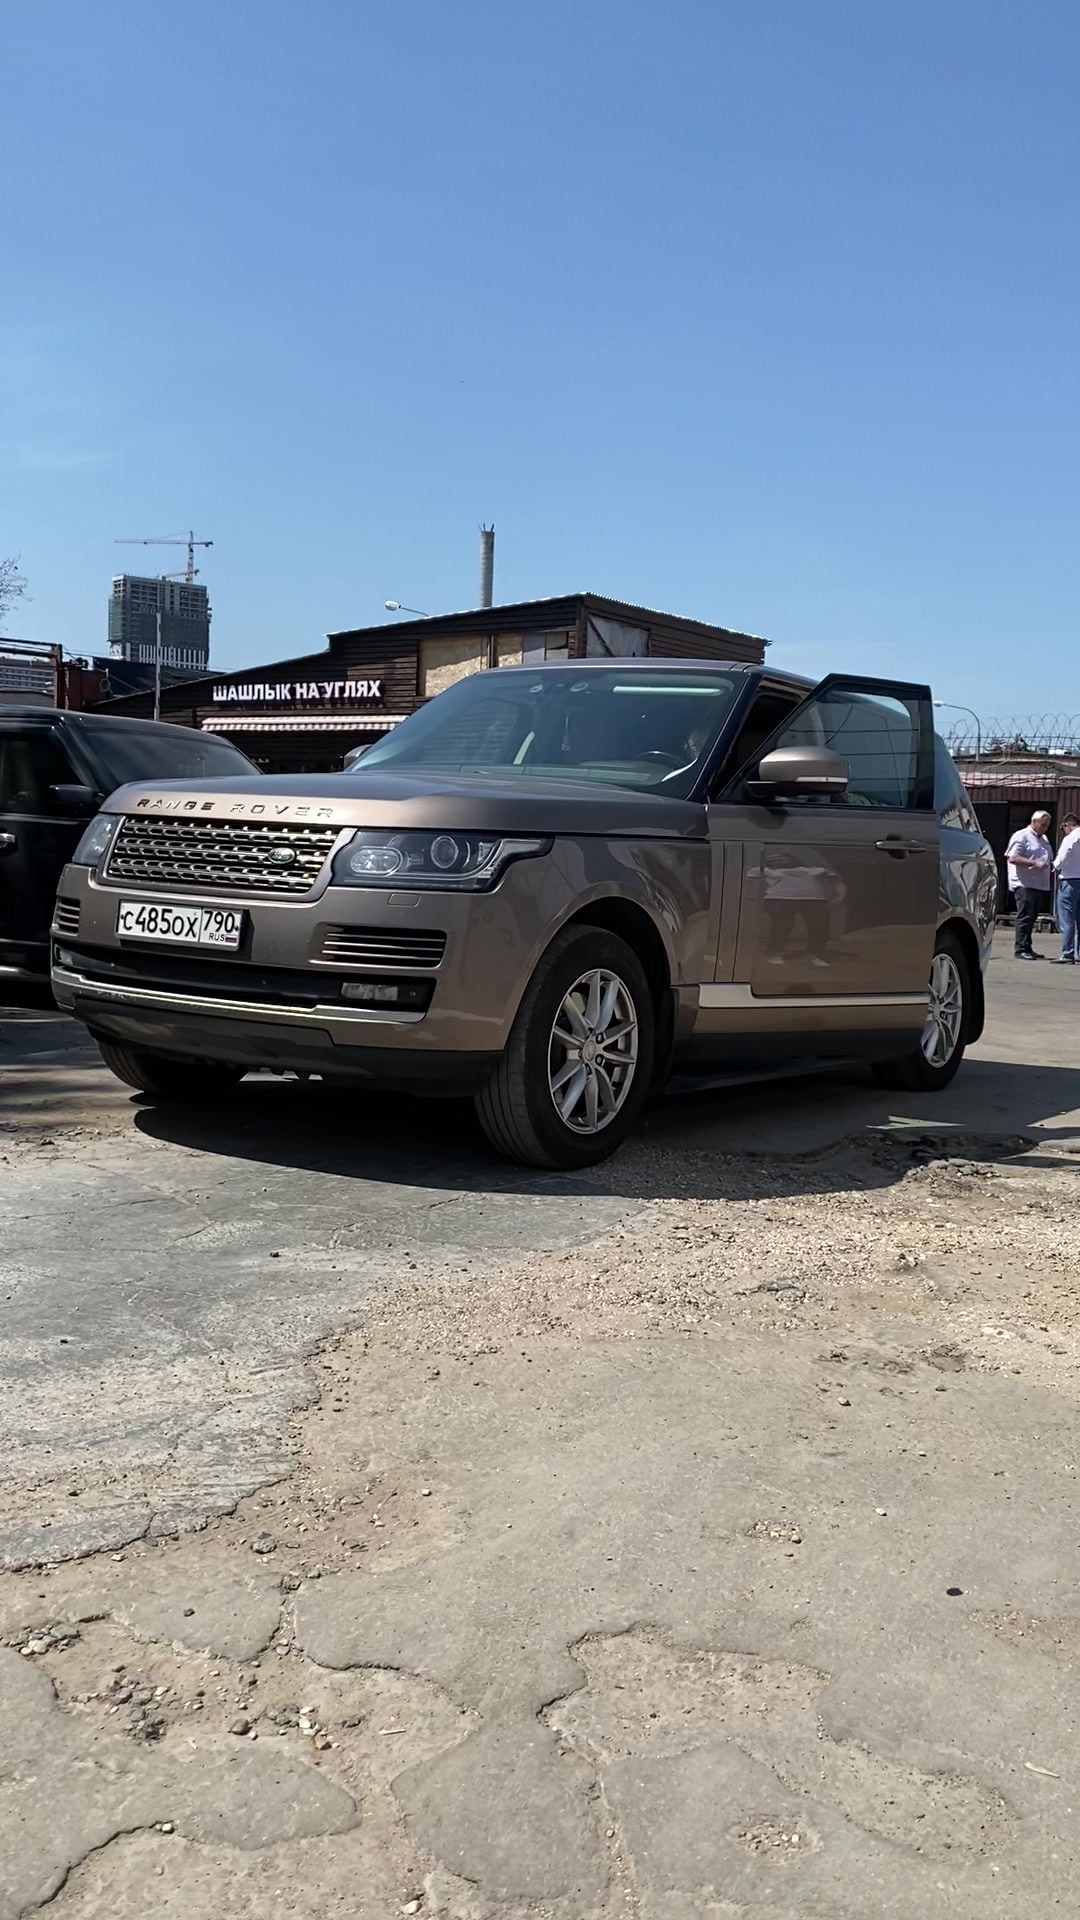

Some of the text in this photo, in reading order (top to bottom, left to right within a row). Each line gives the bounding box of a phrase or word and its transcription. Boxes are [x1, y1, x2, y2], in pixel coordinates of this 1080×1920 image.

[212, 680, 381, 701] ШАШЛЫК НА УГЛЯХ
[137, 798, 334, 818] RANGE ROVER
[204, 910, 236, 933] 790
[209, 933, 225, 942] RUS
